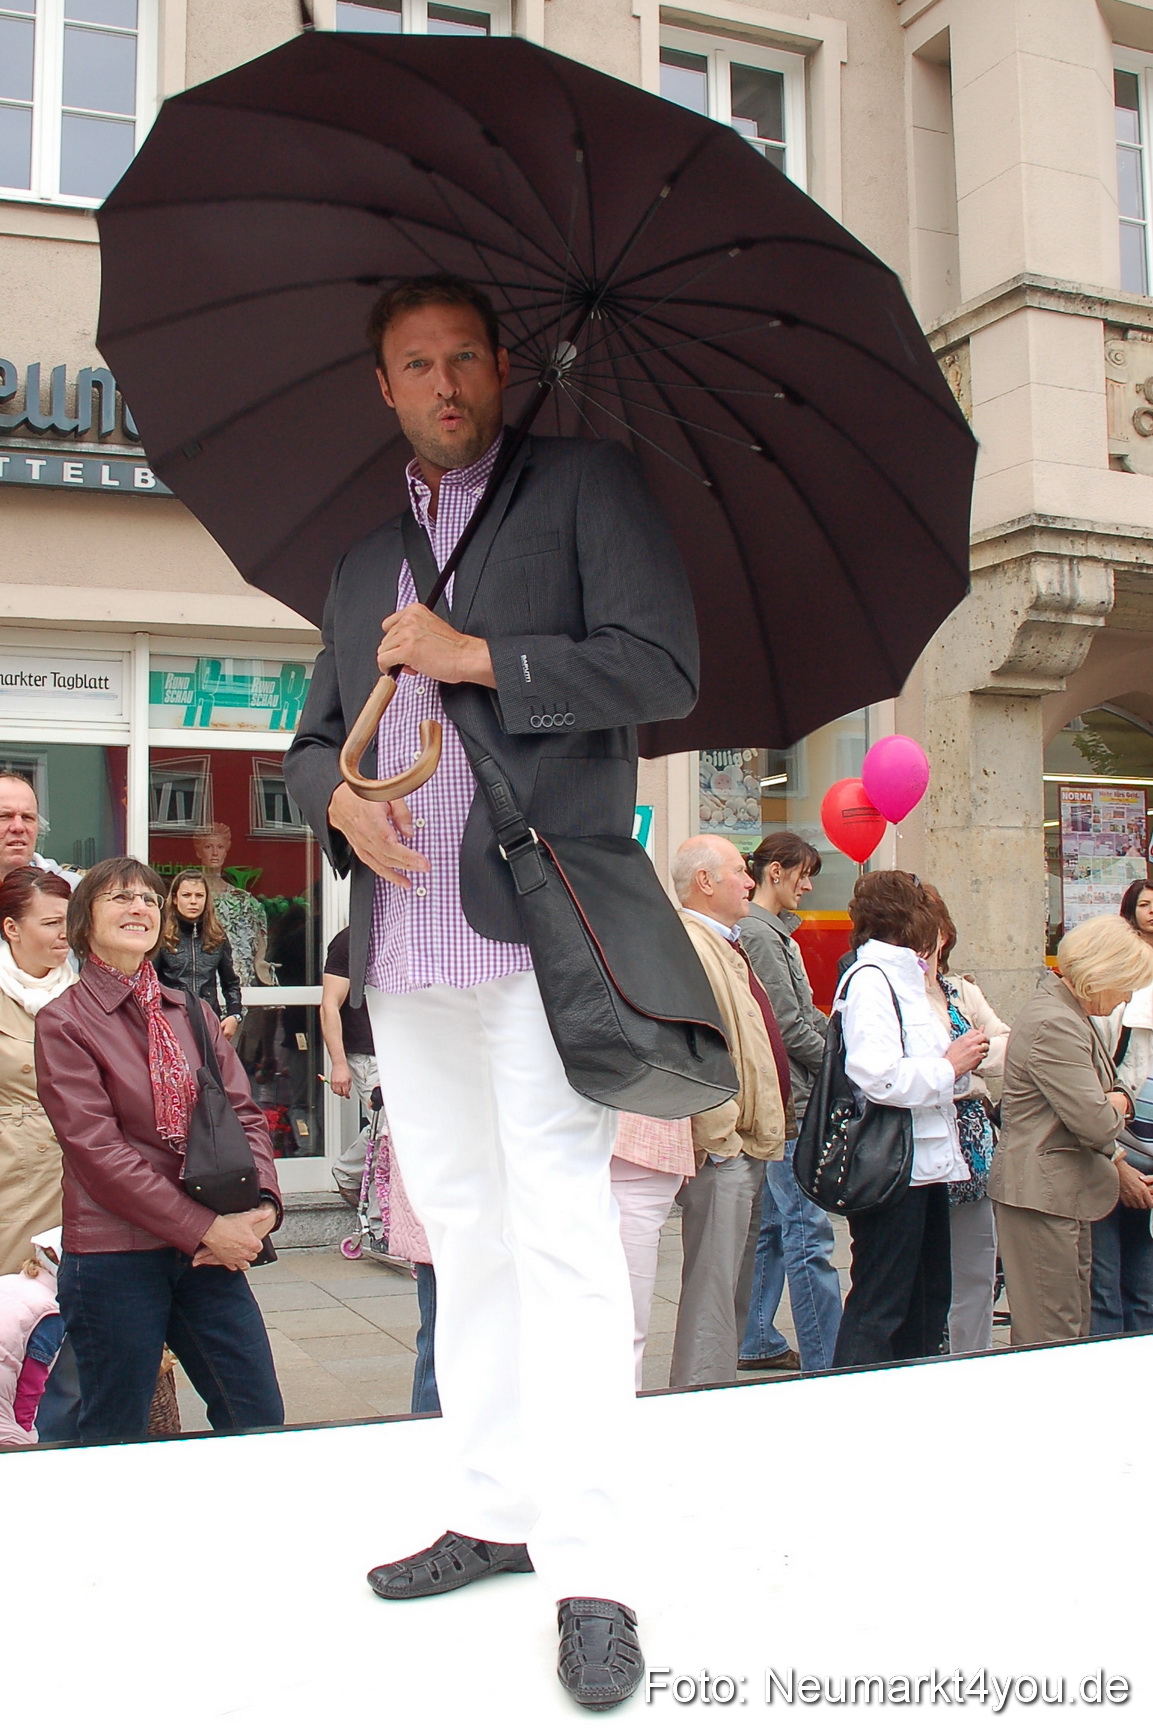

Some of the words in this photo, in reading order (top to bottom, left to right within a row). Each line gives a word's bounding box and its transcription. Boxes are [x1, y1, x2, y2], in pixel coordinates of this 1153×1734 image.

[50, 671, 110, 690] Tagblatt
[164, 690, 194, 704] SCHAU
[250, 693, 279, 708] SCHAU
[1062, 791, 1093, 801] NORMA
